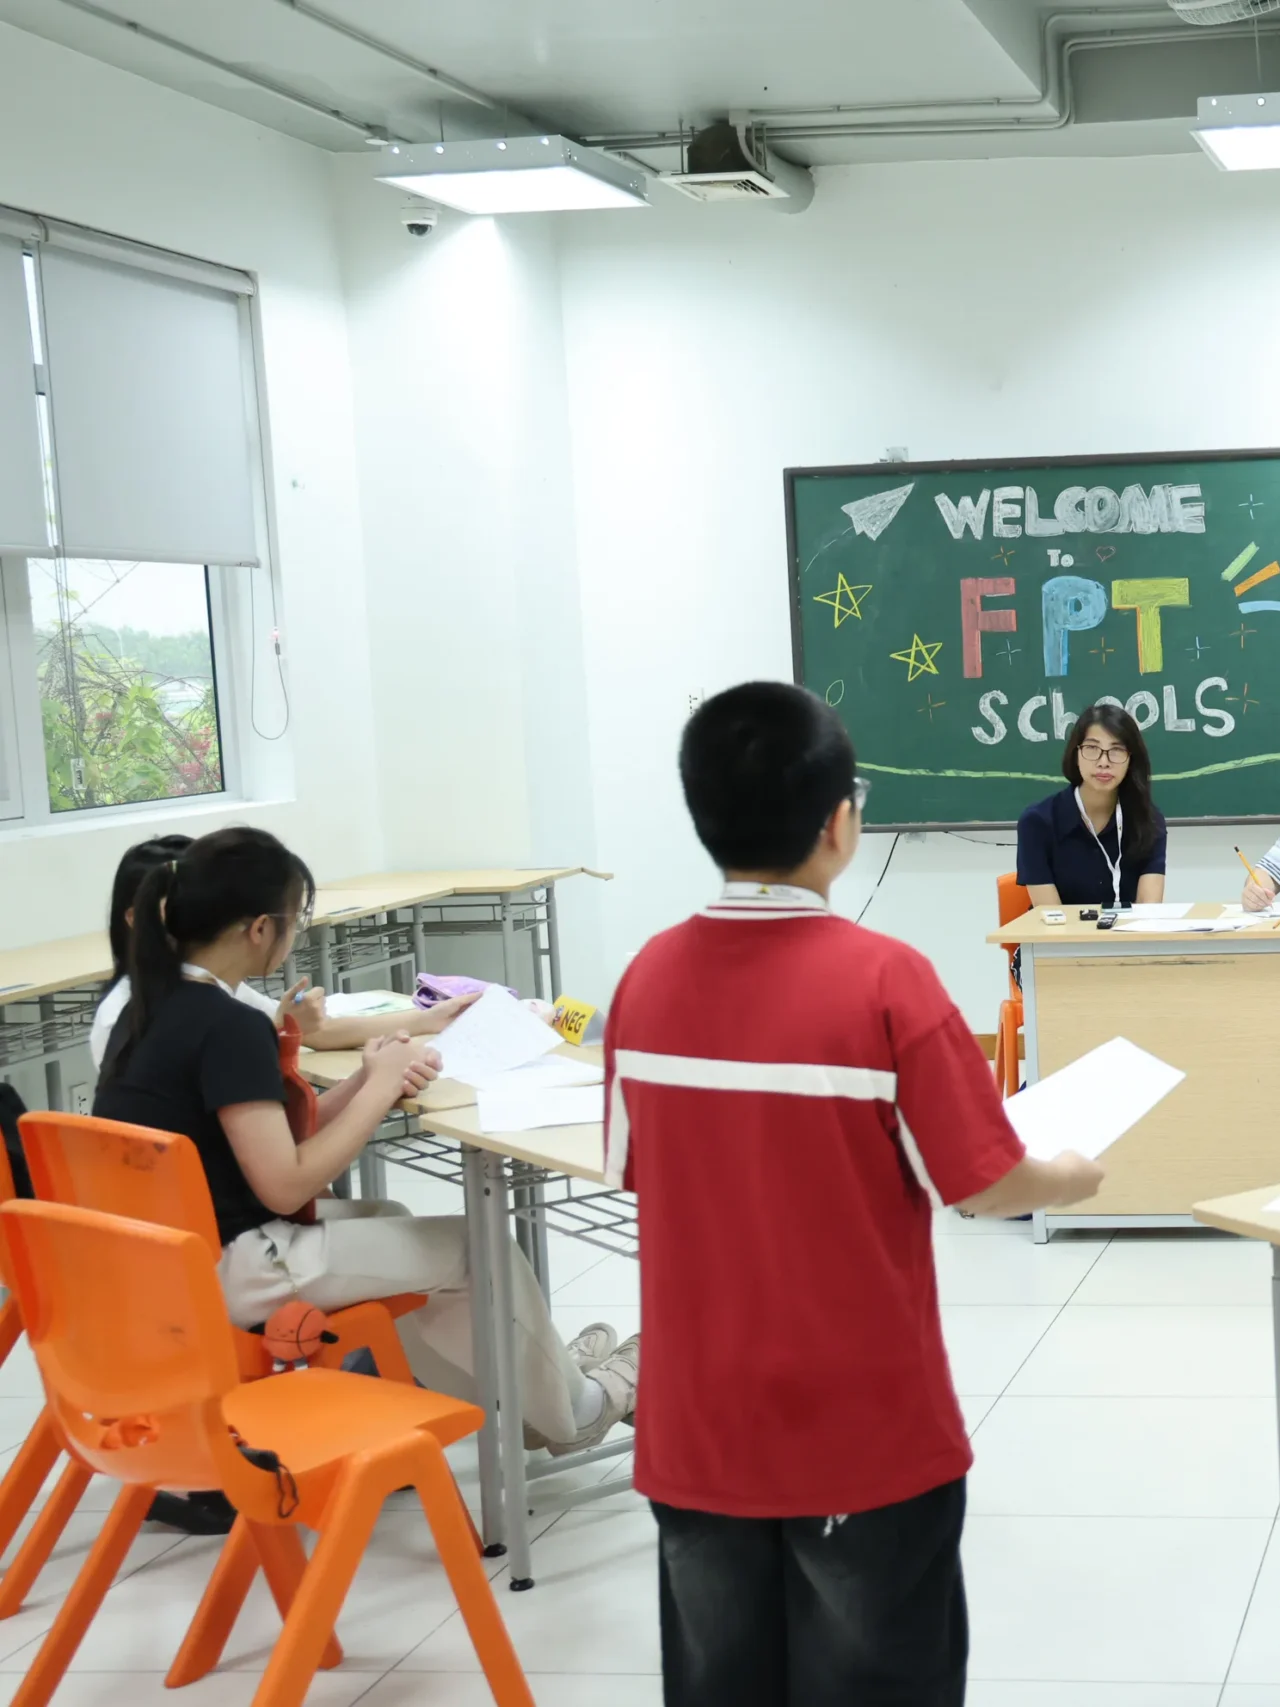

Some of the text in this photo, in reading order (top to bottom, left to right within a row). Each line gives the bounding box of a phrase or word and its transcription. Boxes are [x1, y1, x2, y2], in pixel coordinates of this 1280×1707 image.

[934, 483, 1206, 540] WELCOME
[960, 575, 1192, 679] FPT
[560, 1008, 586, 1034] NEG
